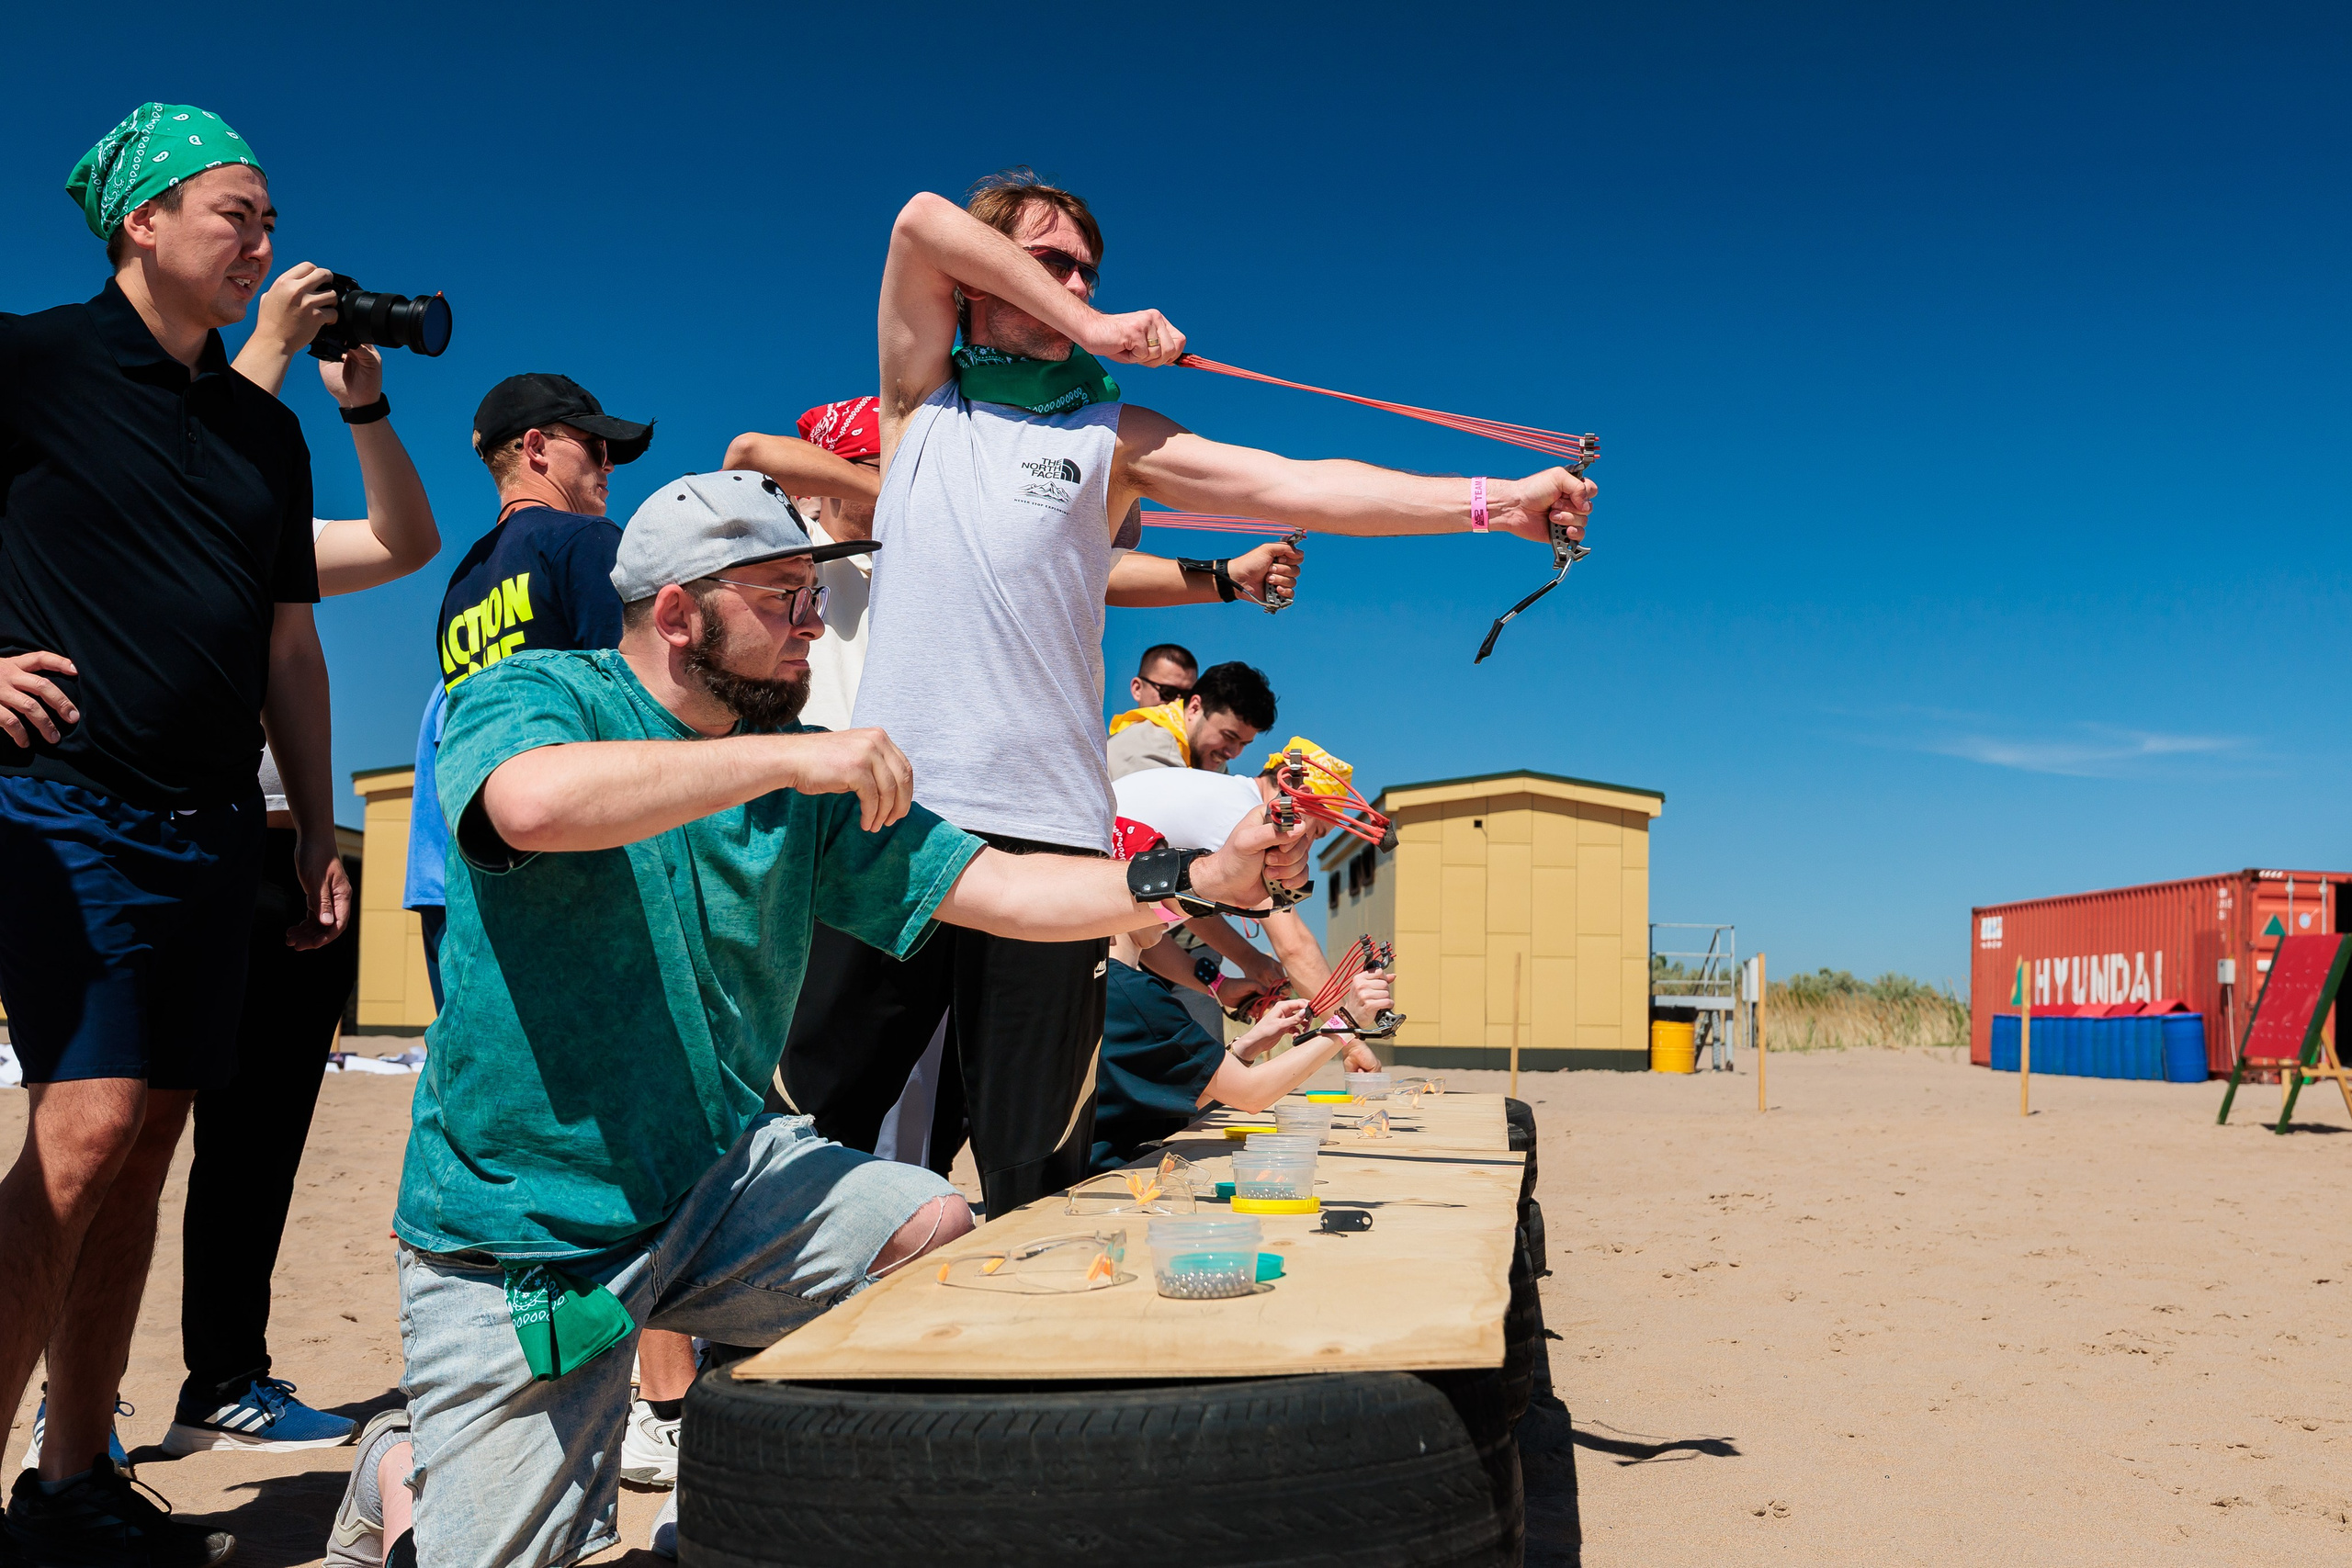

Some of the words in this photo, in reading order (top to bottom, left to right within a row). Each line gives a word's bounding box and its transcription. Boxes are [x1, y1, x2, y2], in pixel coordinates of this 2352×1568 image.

[1042, 457, 1062, 466] THE
[1021, 462, 1061, 471] NORTH
[1031, 469, 1060, 479] FACE
[2034, 950, 2163, 1007] HYUNDAI
